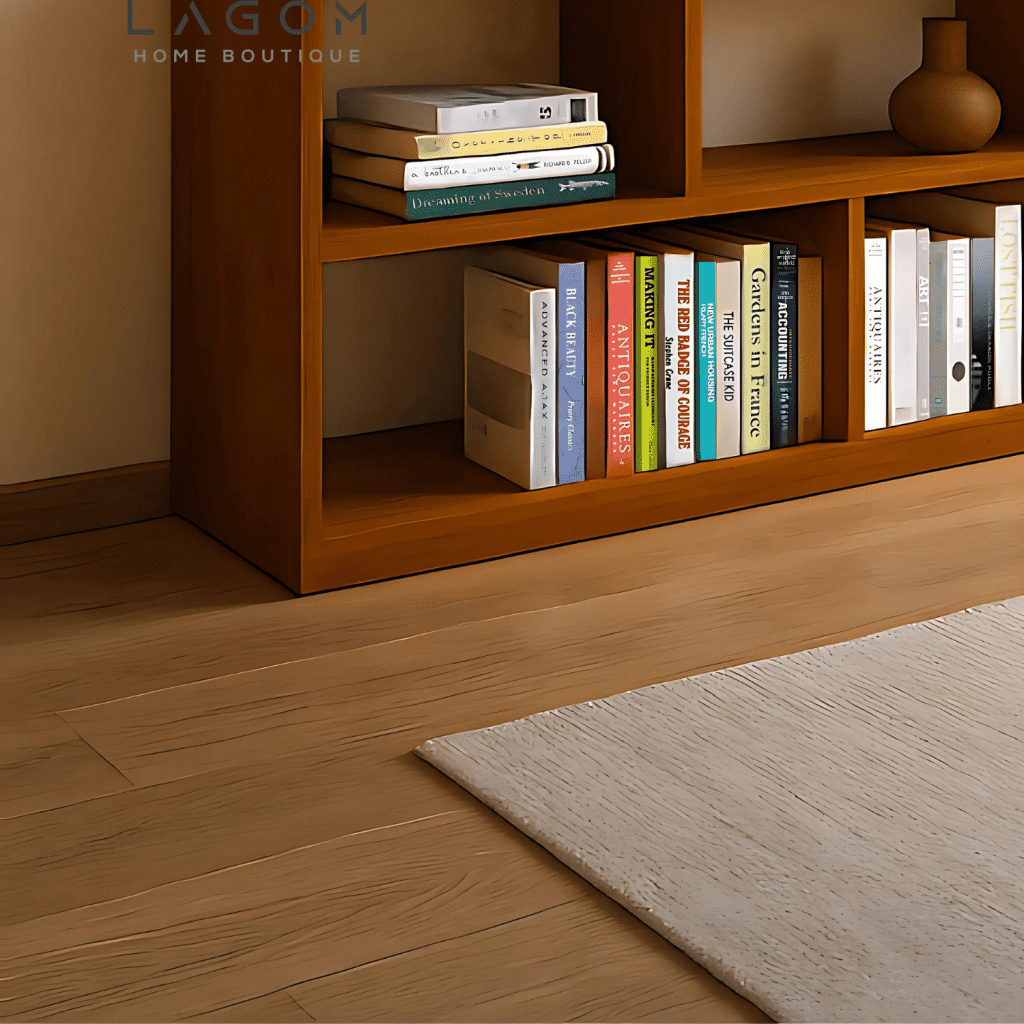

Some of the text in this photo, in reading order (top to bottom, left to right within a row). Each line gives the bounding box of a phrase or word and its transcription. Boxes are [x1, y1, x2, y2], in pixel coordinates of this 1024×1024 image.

[412, 186, 546, 210] Dreaming of Sweden
[565, 287, 577, 378] BLACK BEAUTY
[645, 267, 655, 348] MAKING IT
[871, 287, 883, 384] ANTIQUAIRES
[919, 275, 929, 305] ART
[665, 336, 674, 390] Stephen Crane
[677, 279, 691, 450] THE RED BADGE OF COURAGE
[723, 311, 735, 402] THE SUITCASE KID
[750, 267, 767, 438] Gardens in France
[777, 301, 788, 381] ACCOUNTING
[616, 324, 631, 454] ANTIQUAIRES
